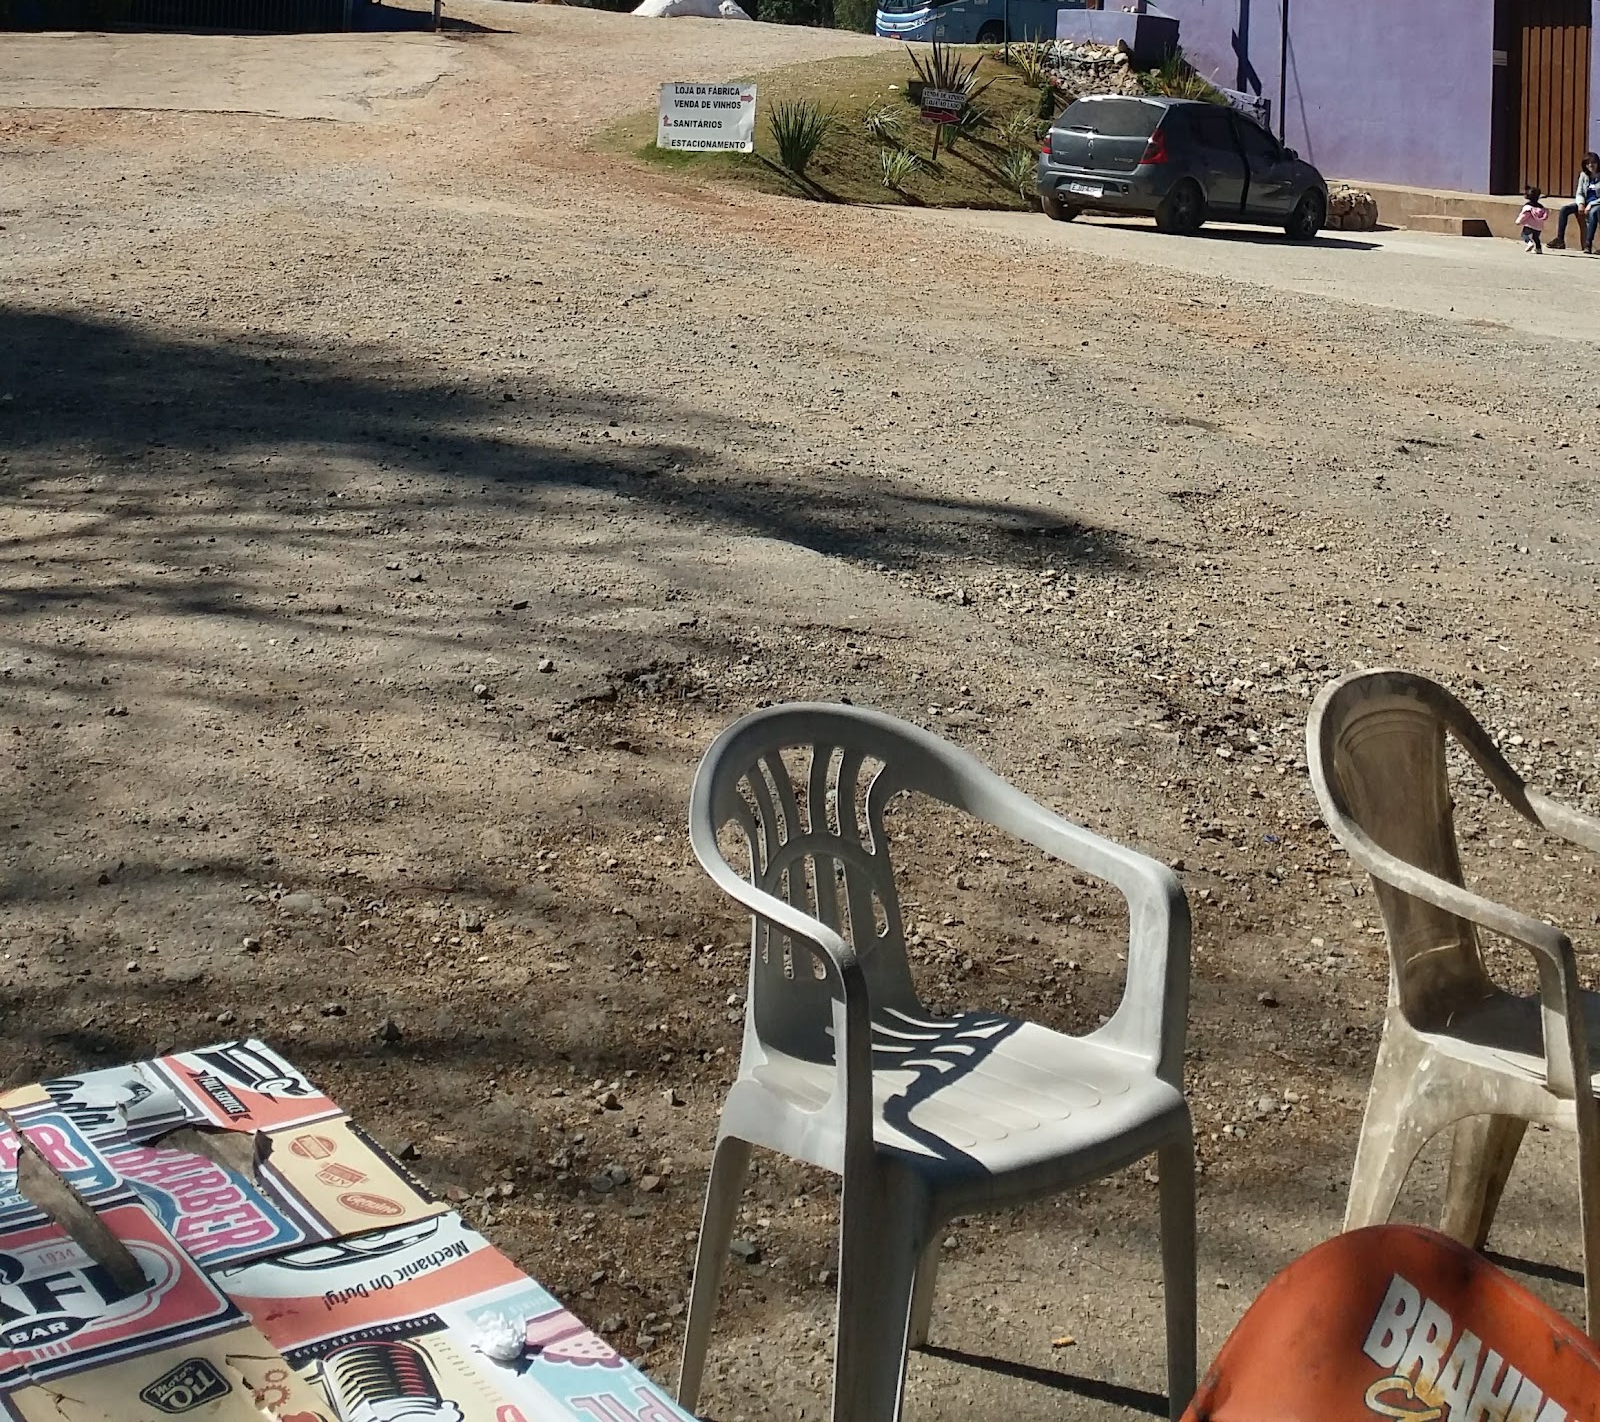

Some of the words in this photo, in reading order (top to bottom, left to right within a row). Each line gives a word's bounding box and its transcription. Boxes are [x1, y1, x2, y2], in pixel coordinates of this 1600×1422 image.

[675, 86, 695, 95] LOJA
[696, 87, 707, 95] DA
[708, 86, 740, 96] FÁBRICA
[674, 100, 699, 108] VENDA
[701, 101, 711, 109] DE
[713, 101, 741, 110] VINHOS
[673, 119, 723, 129] SANITÁRIOS
[671, 139, 746, 149] ESTACIONAMENTO
[199, 1078, 223, 1092] FULL
[37, 1247, 77, 1265] 1934
[393, 1239, 470, 1282] Mechanic
[369, 1274, 395, 1290] On
[322, 1283, 370, 1311] Duty!
[9, 1322, 70, 1344] BAR
[150, 1365, 196, 1396] Motor
[160, 1370, 216, 1408] Oil
